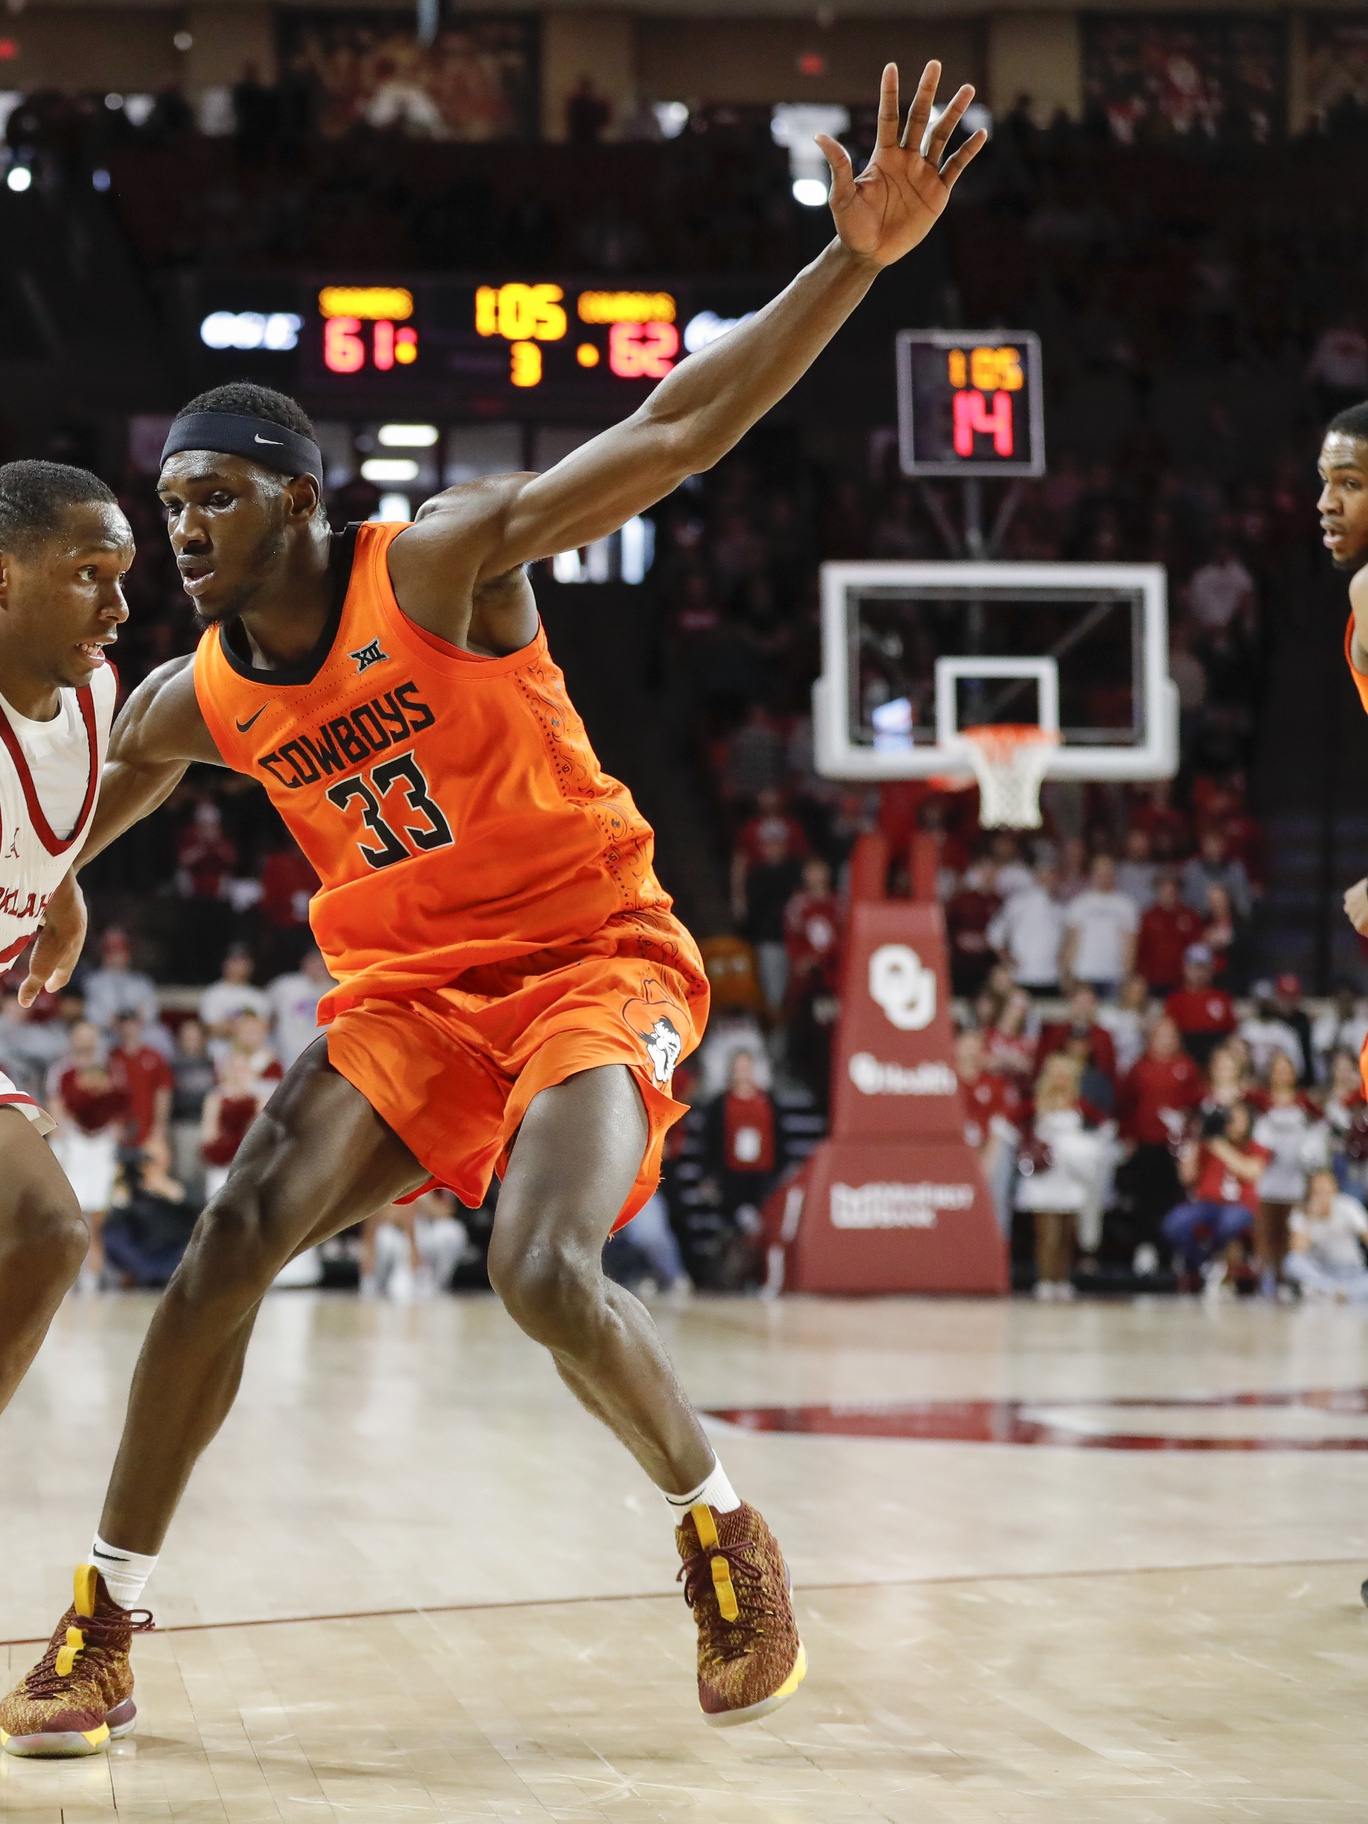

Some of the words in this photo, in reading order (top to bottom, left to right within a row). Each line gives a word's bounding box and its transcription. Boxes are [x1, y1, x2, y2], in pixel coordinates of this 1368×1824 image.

[324, 317, 395, 372] 61
[609, 321, 679, 378] 62
[953, 389, 1014, 457] 14
[258, 681, 435, 789] COWBOYS
[326, 749, 455, 870] 33
[869, 944, 936, 1031] OU
